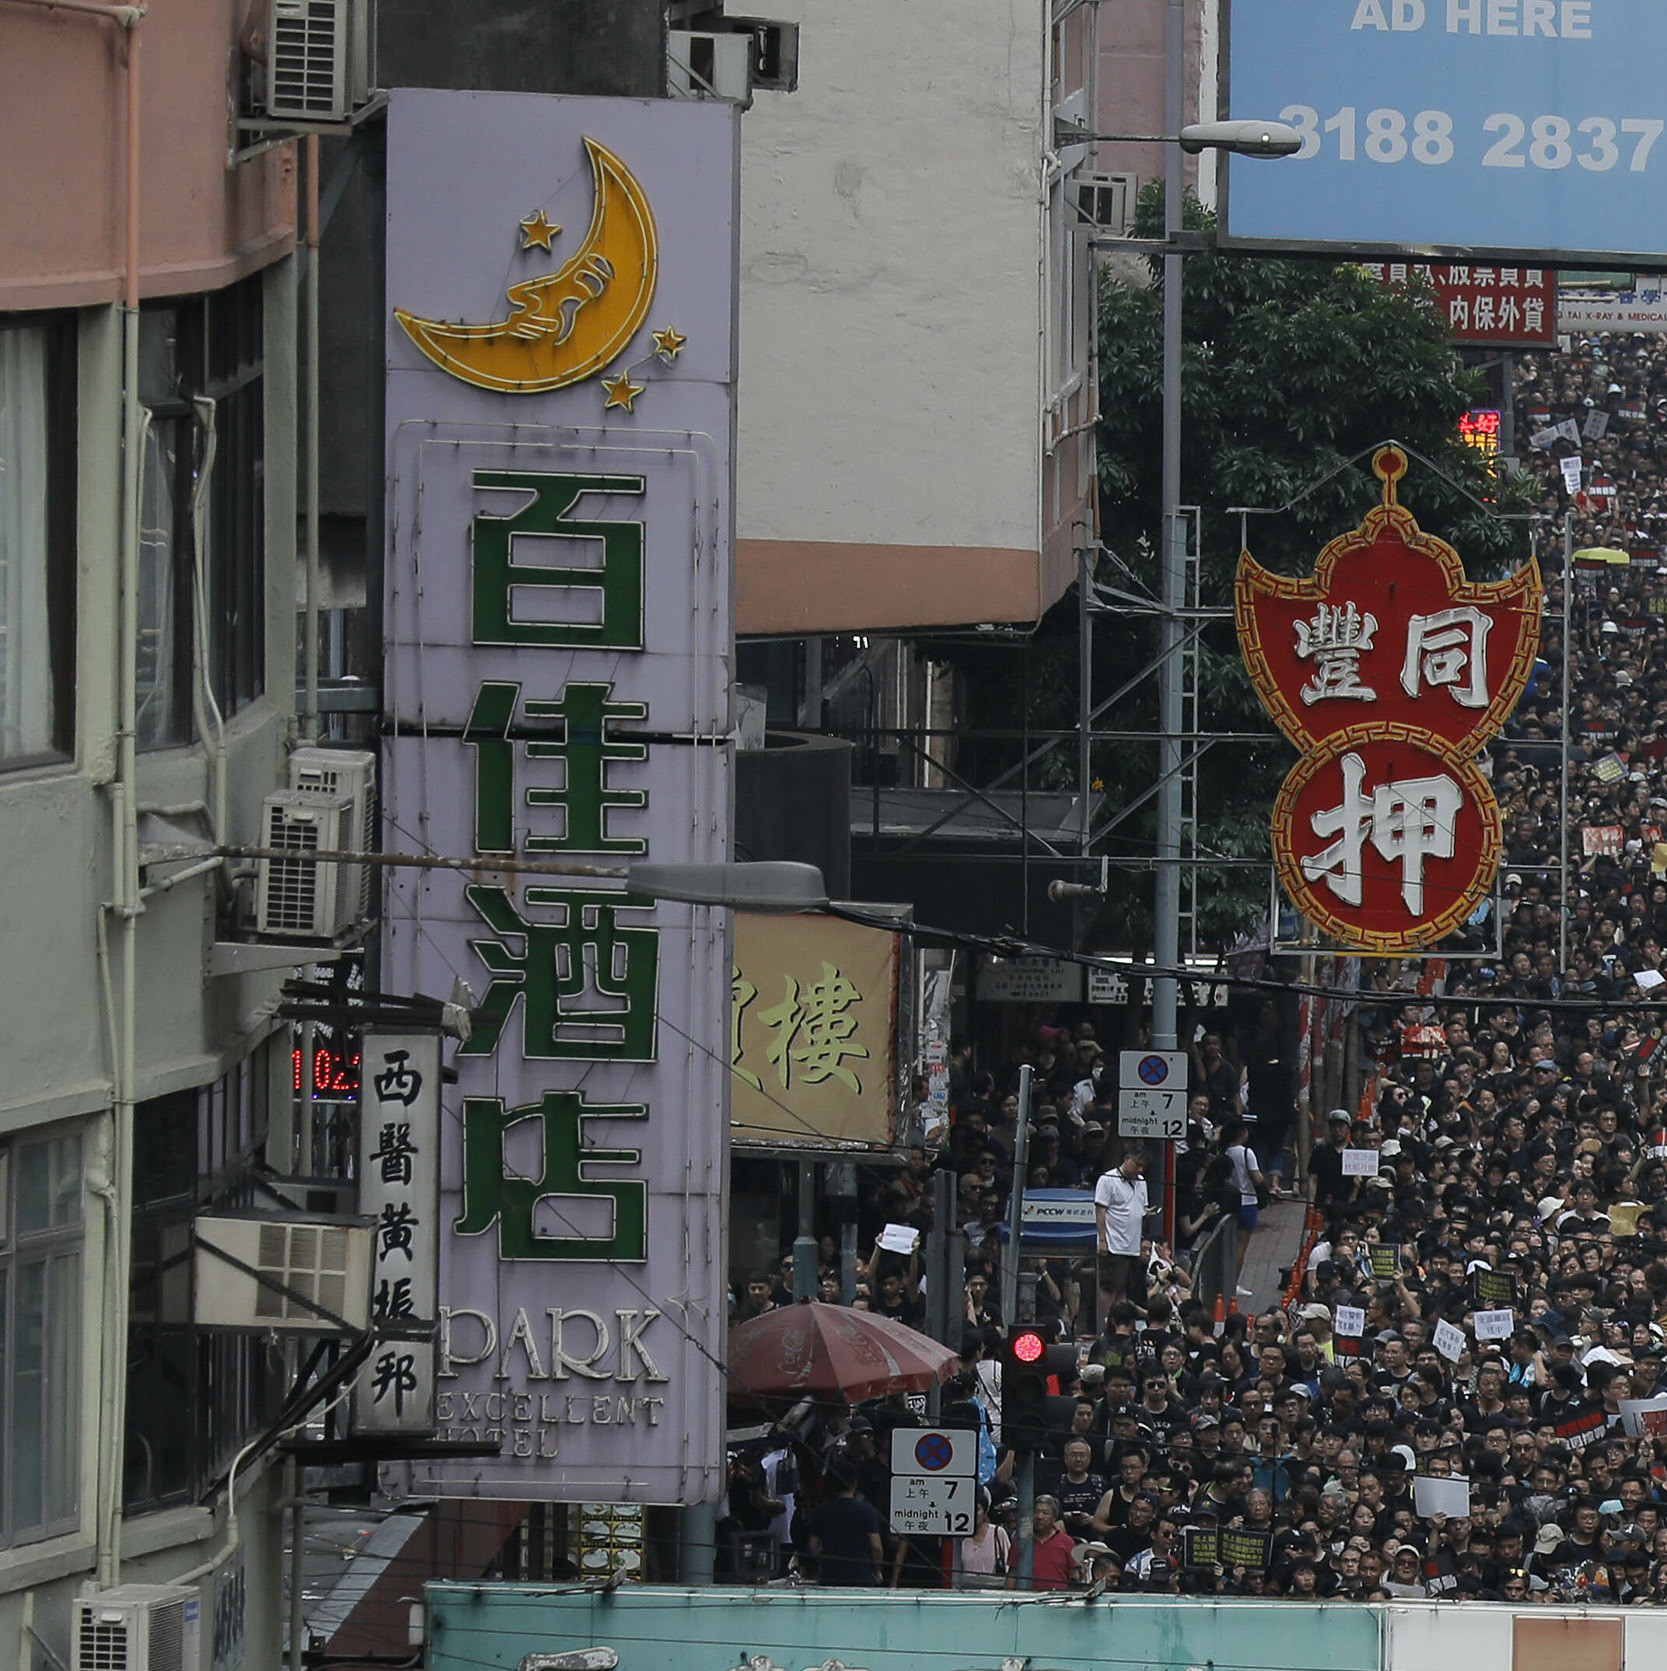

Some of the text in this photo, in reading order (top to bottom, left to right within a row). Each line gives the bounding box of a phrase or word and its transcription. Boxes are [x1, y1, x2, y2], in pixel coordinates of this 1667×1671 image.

[1350, 0, 1594, 39] AD HERE
[1279, 103, 1667, 173] 3188 2837
[1585, 312, 1613, 322] X-RAY
[1627, 312, 1667, 322] MEDICAL
[1300, 752, 1461, 917] 押
[456, 468, 659, 1262] 百佳酒店
[1162, 1094, 1174, 1110] 7
[1162, 1120, 1182, 1136] 12
[438, 1304, 669, 1383] PARK
[437, 1393, 665, 1426] EXCELLENT
[944, 1481, 958, 1499] 7
[894, 1508, 969, 1532] midnight 12
